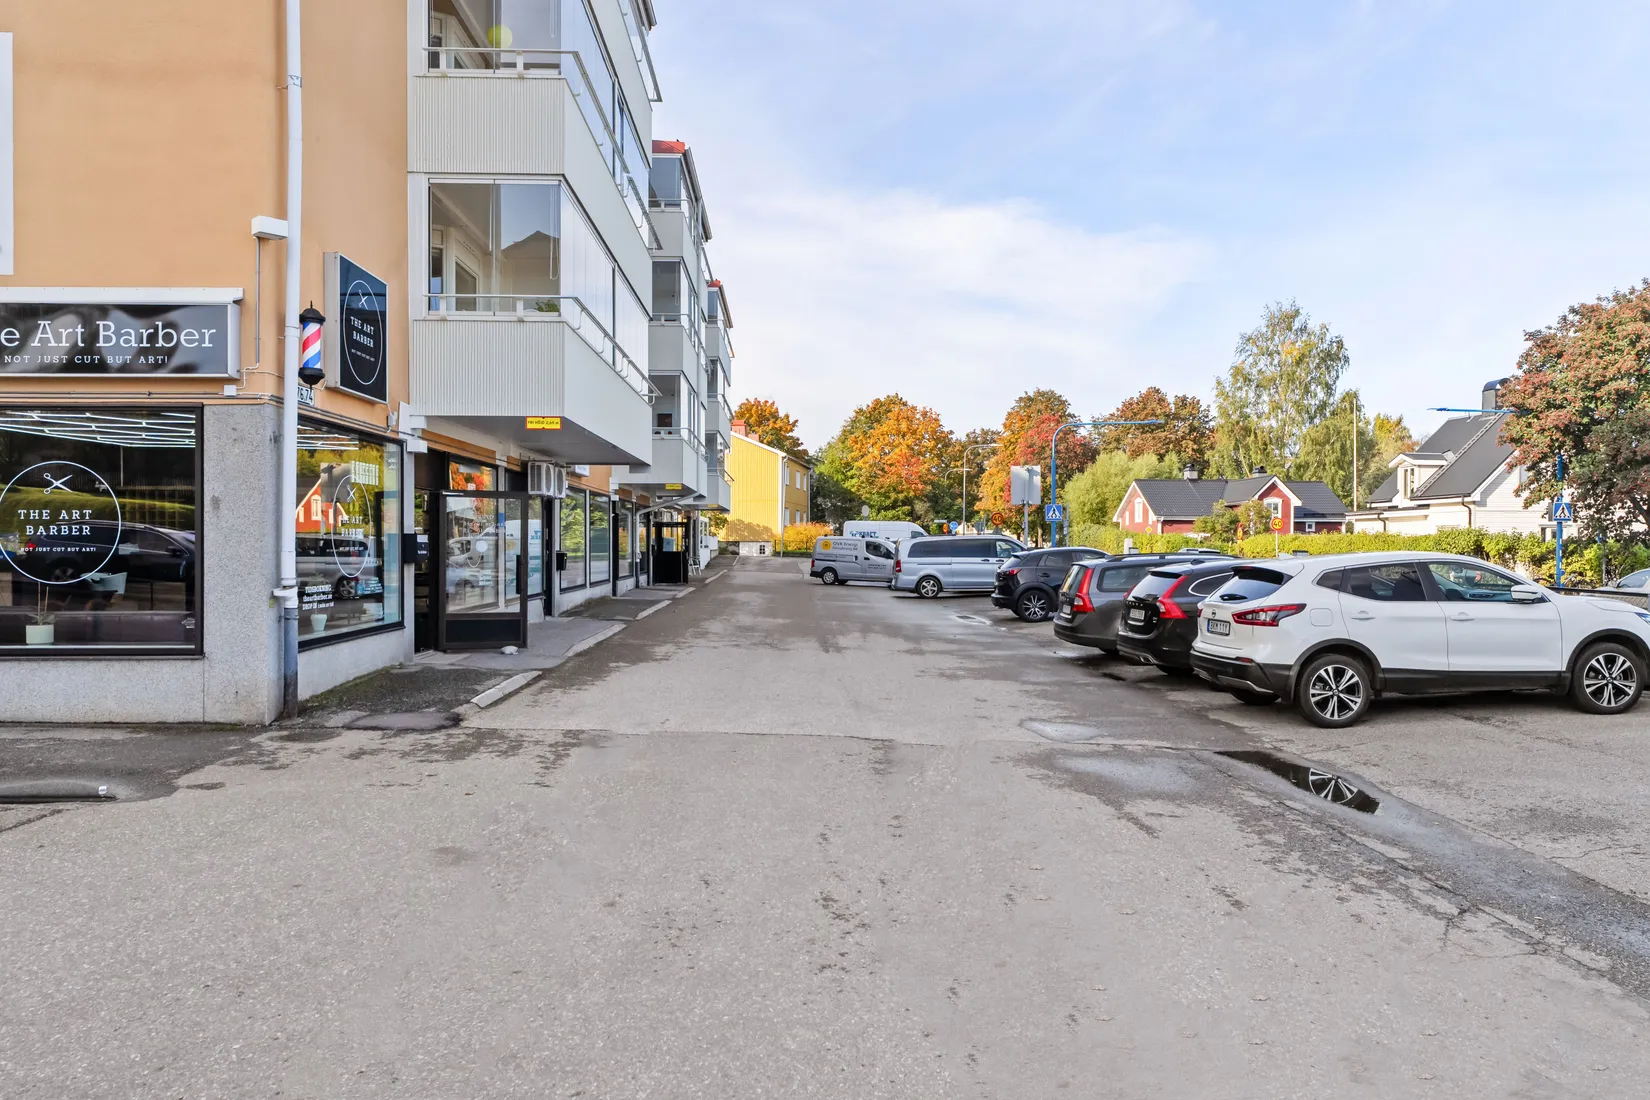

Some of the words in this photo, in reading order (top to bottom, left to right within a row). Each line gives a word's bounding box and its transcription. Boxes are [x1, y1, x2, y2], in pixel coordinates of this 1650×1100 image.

[350, 316, 362, 328] THE
[30, 320, 84, 347] Art
[96, 320, 216, 348] Barber
[353, 330, 374, 347] BARBER
[4, 355, 30, 363] NOT
[37, 355, 68, 363] JUST
[74, 355, 100, 363] CUT
[107, 355, 132, 363] BUT
[139, 356, 168, 364] ART!
[18, 510, 50, 520] THE
[60, 510, 92, 520] ART
[26, 526, 90, 535] BARBER
